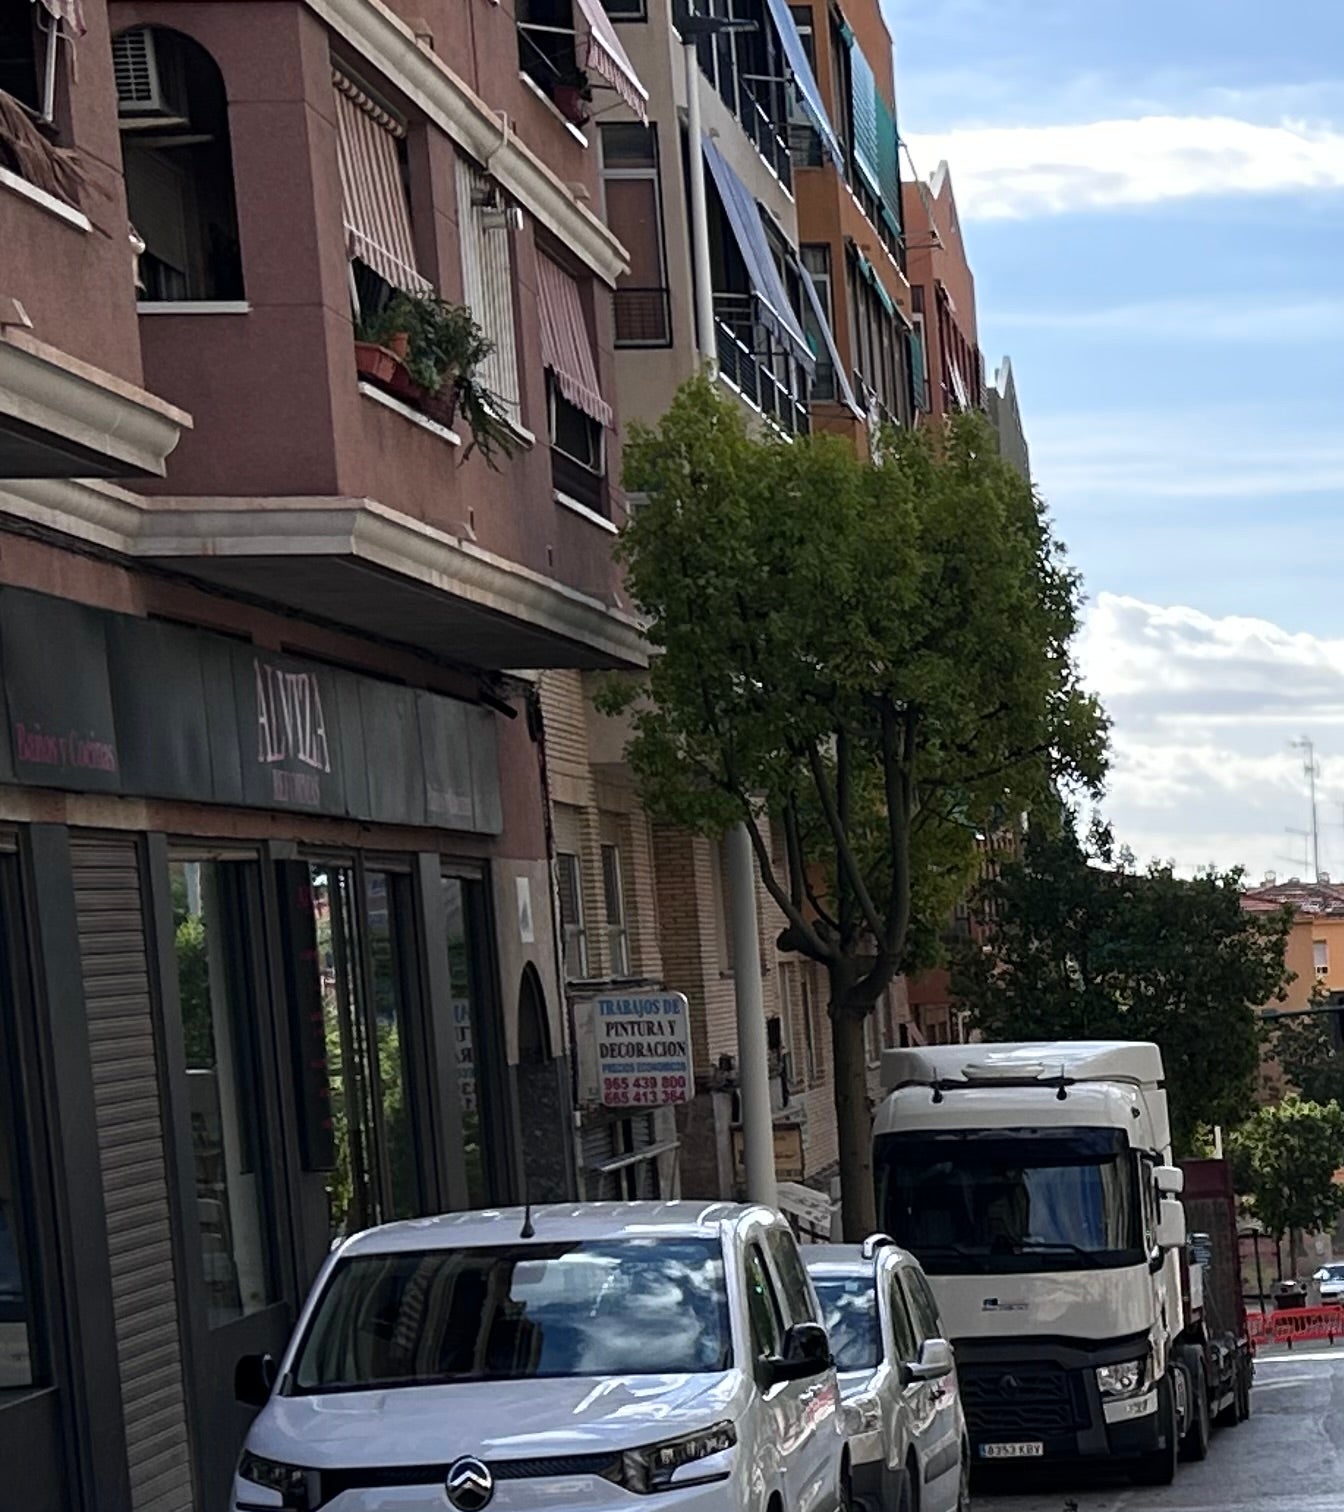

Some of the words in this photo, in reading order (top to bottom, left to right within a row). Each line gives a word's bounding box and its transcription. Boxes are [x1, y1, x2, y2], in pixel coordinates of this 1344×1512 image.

[598, 999, 661, 1018] TRABAJOS
[663, 998, 682, 1016] DE
[605, 1020, 665, 1037] PINTURA
[667, 1020, 677, 1037] Y
[600, 1041, 687, 1059] DECORACION
